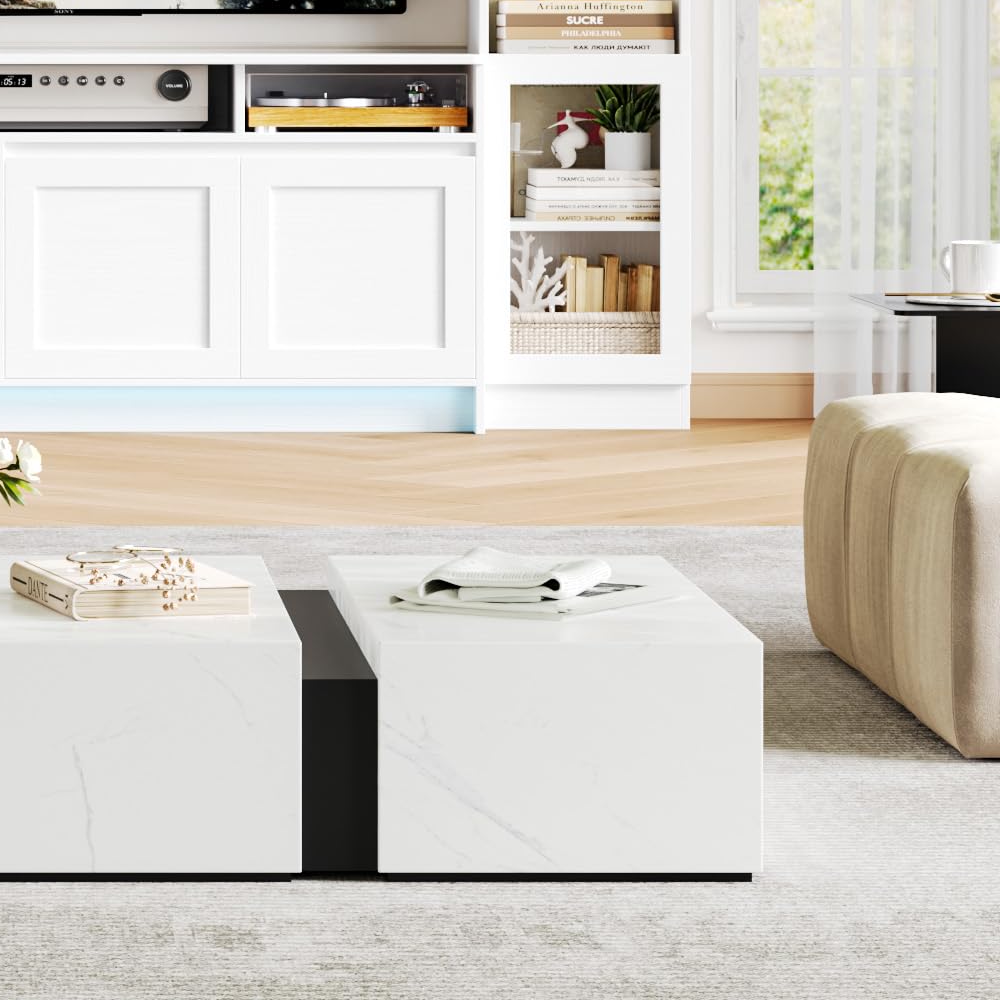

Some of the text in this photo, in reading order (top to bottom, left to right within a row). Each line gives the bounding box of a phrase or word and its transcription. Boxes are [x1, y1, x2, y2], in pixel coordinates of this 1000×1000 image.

[584, 2, 644, 11] Huffington
[566, 16, 604, 25] SUCRE
[27, 576, 49, 603] DANTE
